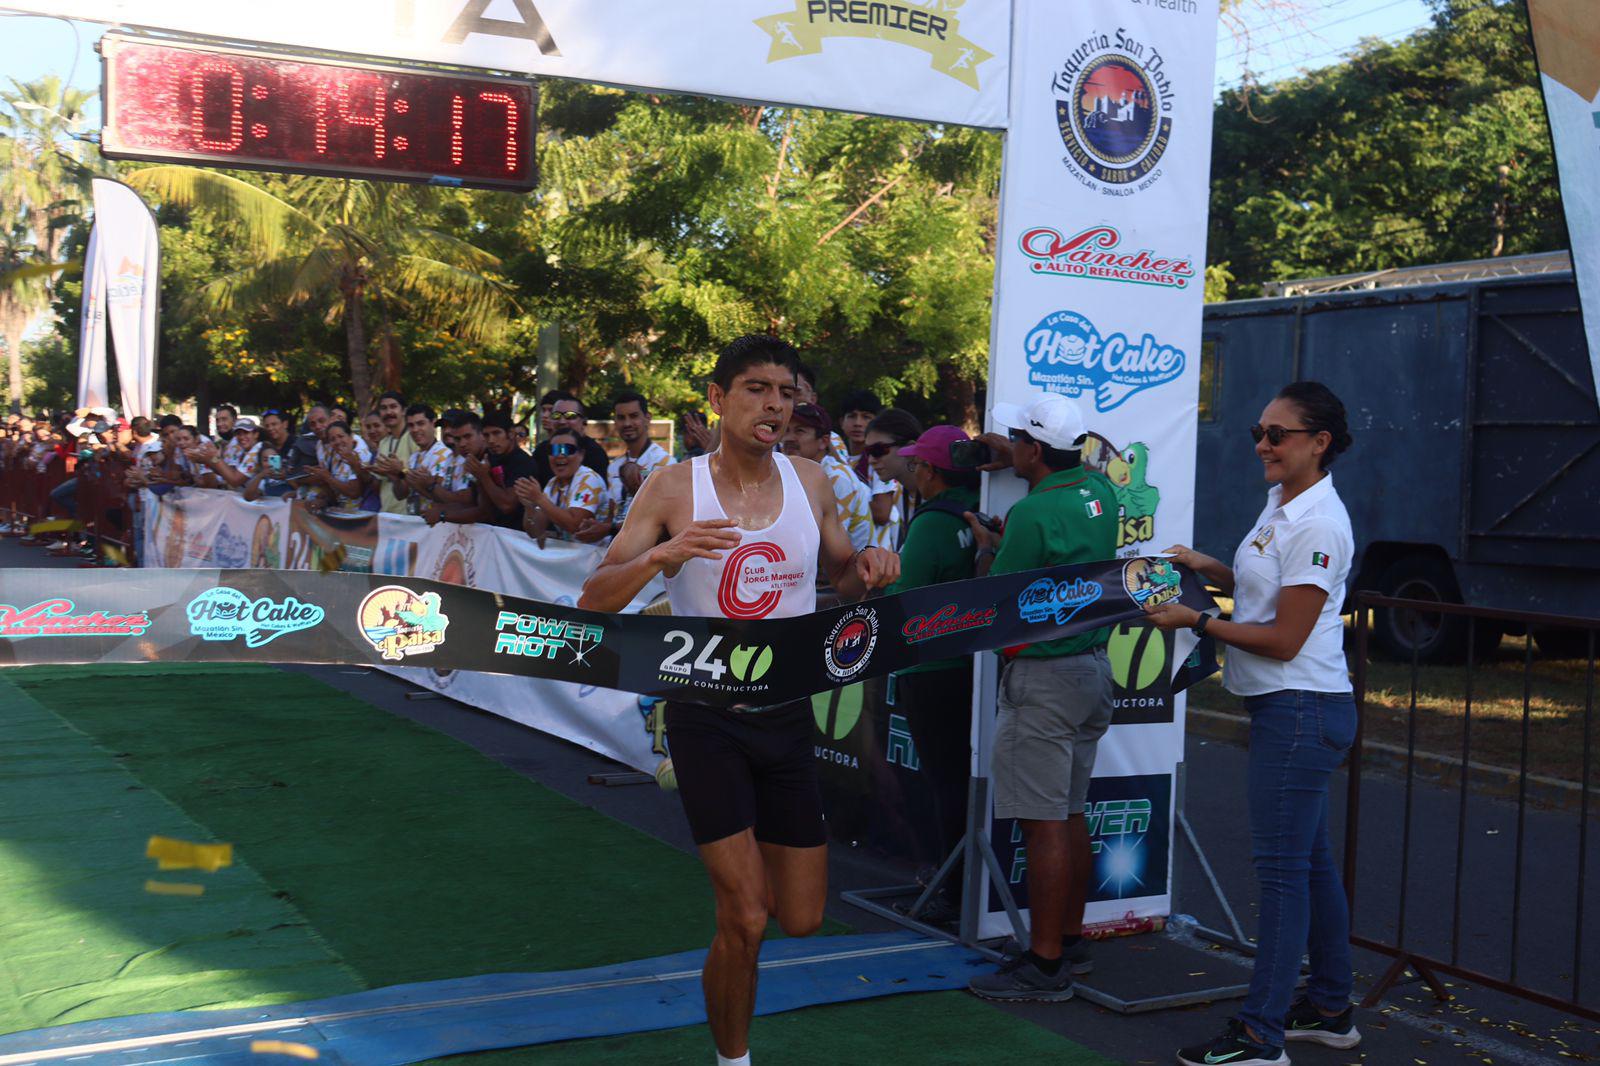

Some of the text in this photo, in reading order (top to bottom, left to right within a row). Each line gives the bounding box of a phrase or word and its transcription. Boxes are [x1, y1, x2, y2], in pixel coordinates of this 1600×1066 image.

[808, 0, 948, 41] PREMIER
[1114, 27, 1144, 59] San
[1142, 46, 1175, 112] Pablo
[1058, 121, 1168, 182] SERVICIO SABOR CALIDAD
[1102, 187, 1135, 197] SINALOA
[1046, 261, 1174, 285] AUTO REFACCIONES
[1047, 313, 1092, 333] La Casa del
[1027, 329, 1183, 373] Hot Cake
[1077, 374, 1095, 386] Sin.
[1116, 514, 1153, 548] isa
[744, 575, 769, 584] JORGE
[1020, 586, 1055, 606] Hot
[190, 599, 320, 623] Hot Cake
[495, 610, 604, 643] POWER
[663, 665, 688, 673] GRUPO
[693, 680, 769, 692] CONSTRUCTORA
[1113, 697, 1164, 708] UCTORA
[814, 745, 859, 769] UCTORA
